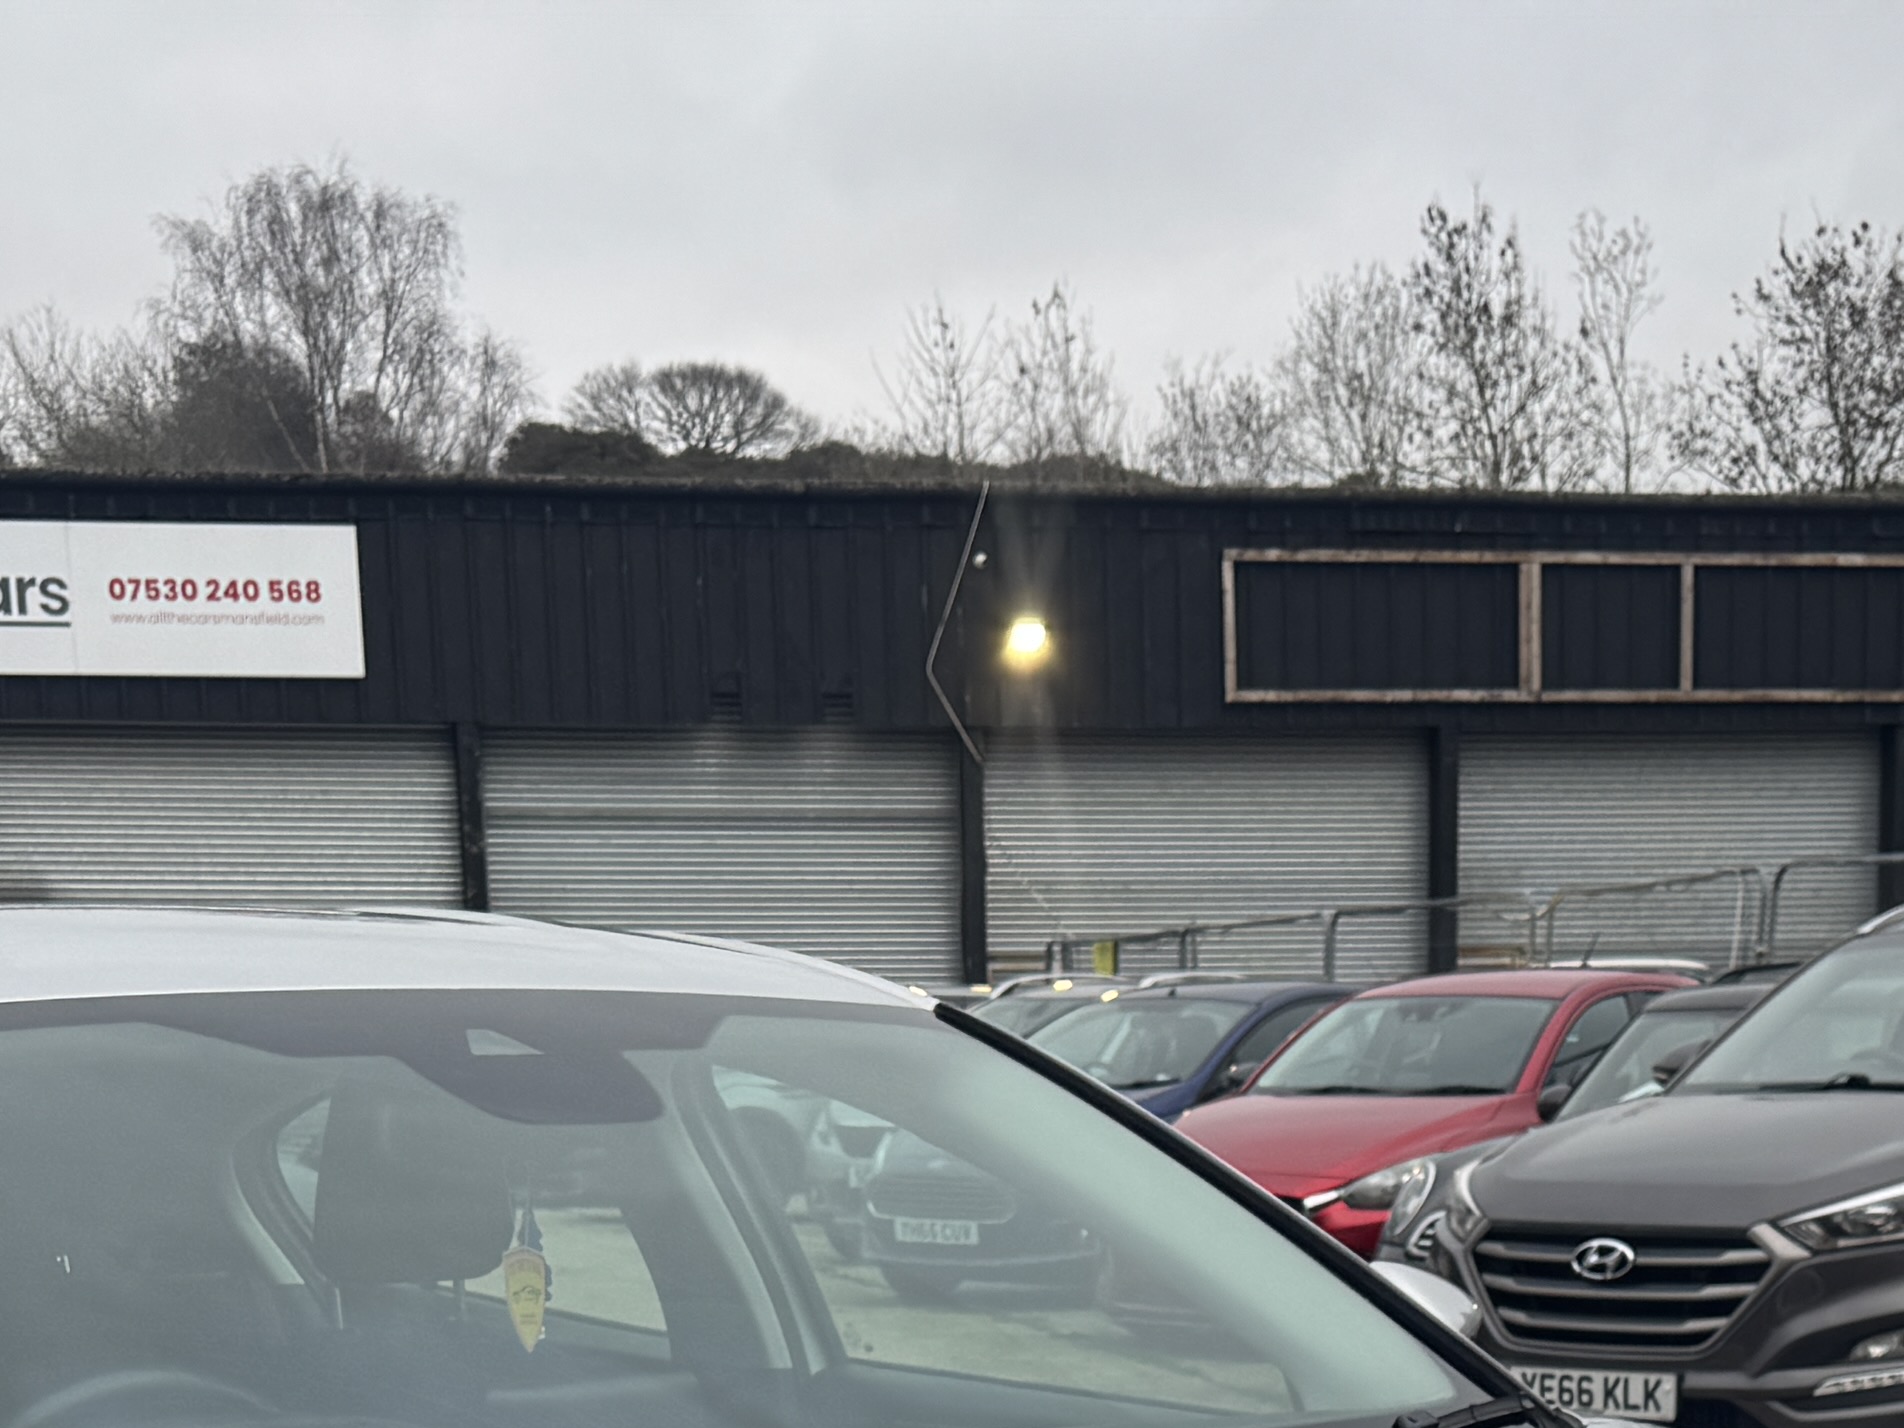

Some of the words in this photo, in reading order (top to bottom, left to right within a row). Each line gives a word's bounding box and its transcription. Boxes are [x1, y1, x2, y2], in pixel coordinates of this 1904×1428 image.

[108, 578, 198, 602] 07530
[205, 579, 260, 602] 240
[268, 579, 322, 603] 568
[1603, 1376, 1662, 1412] KLK
